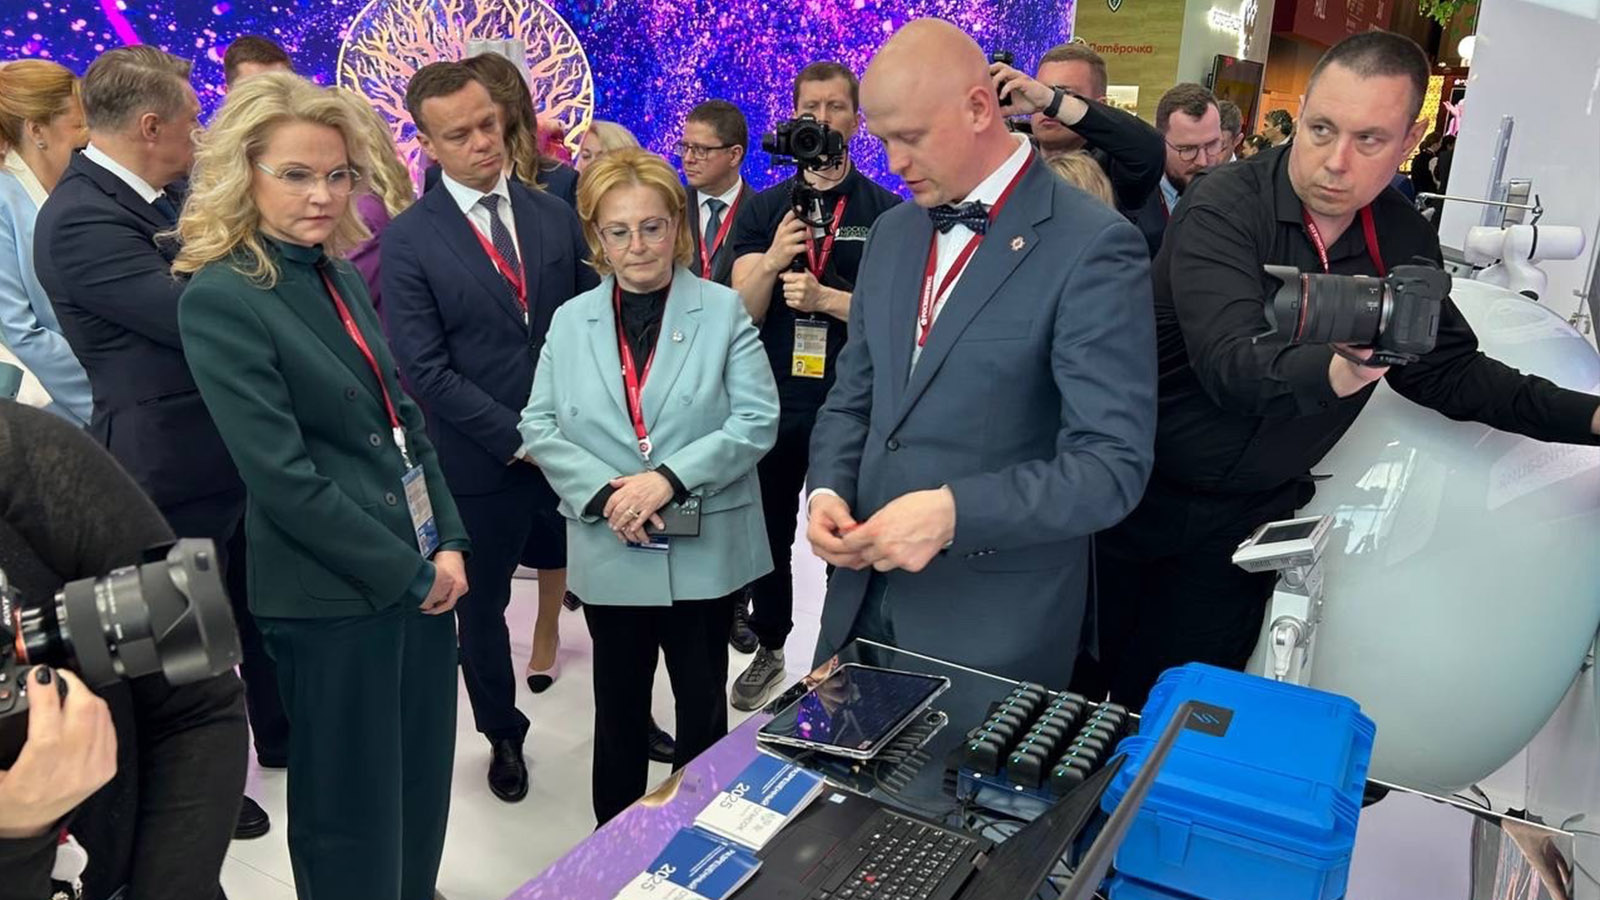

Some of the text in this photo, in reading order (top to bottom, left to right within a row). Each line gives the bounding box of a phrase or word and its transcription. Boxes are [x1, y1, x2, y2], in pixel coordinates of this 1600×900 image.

[1089, 43, 1153, 55] Пятёрочка
[720, 782, 750, 809] 2025
[641, 863, 677, 891] 2025
